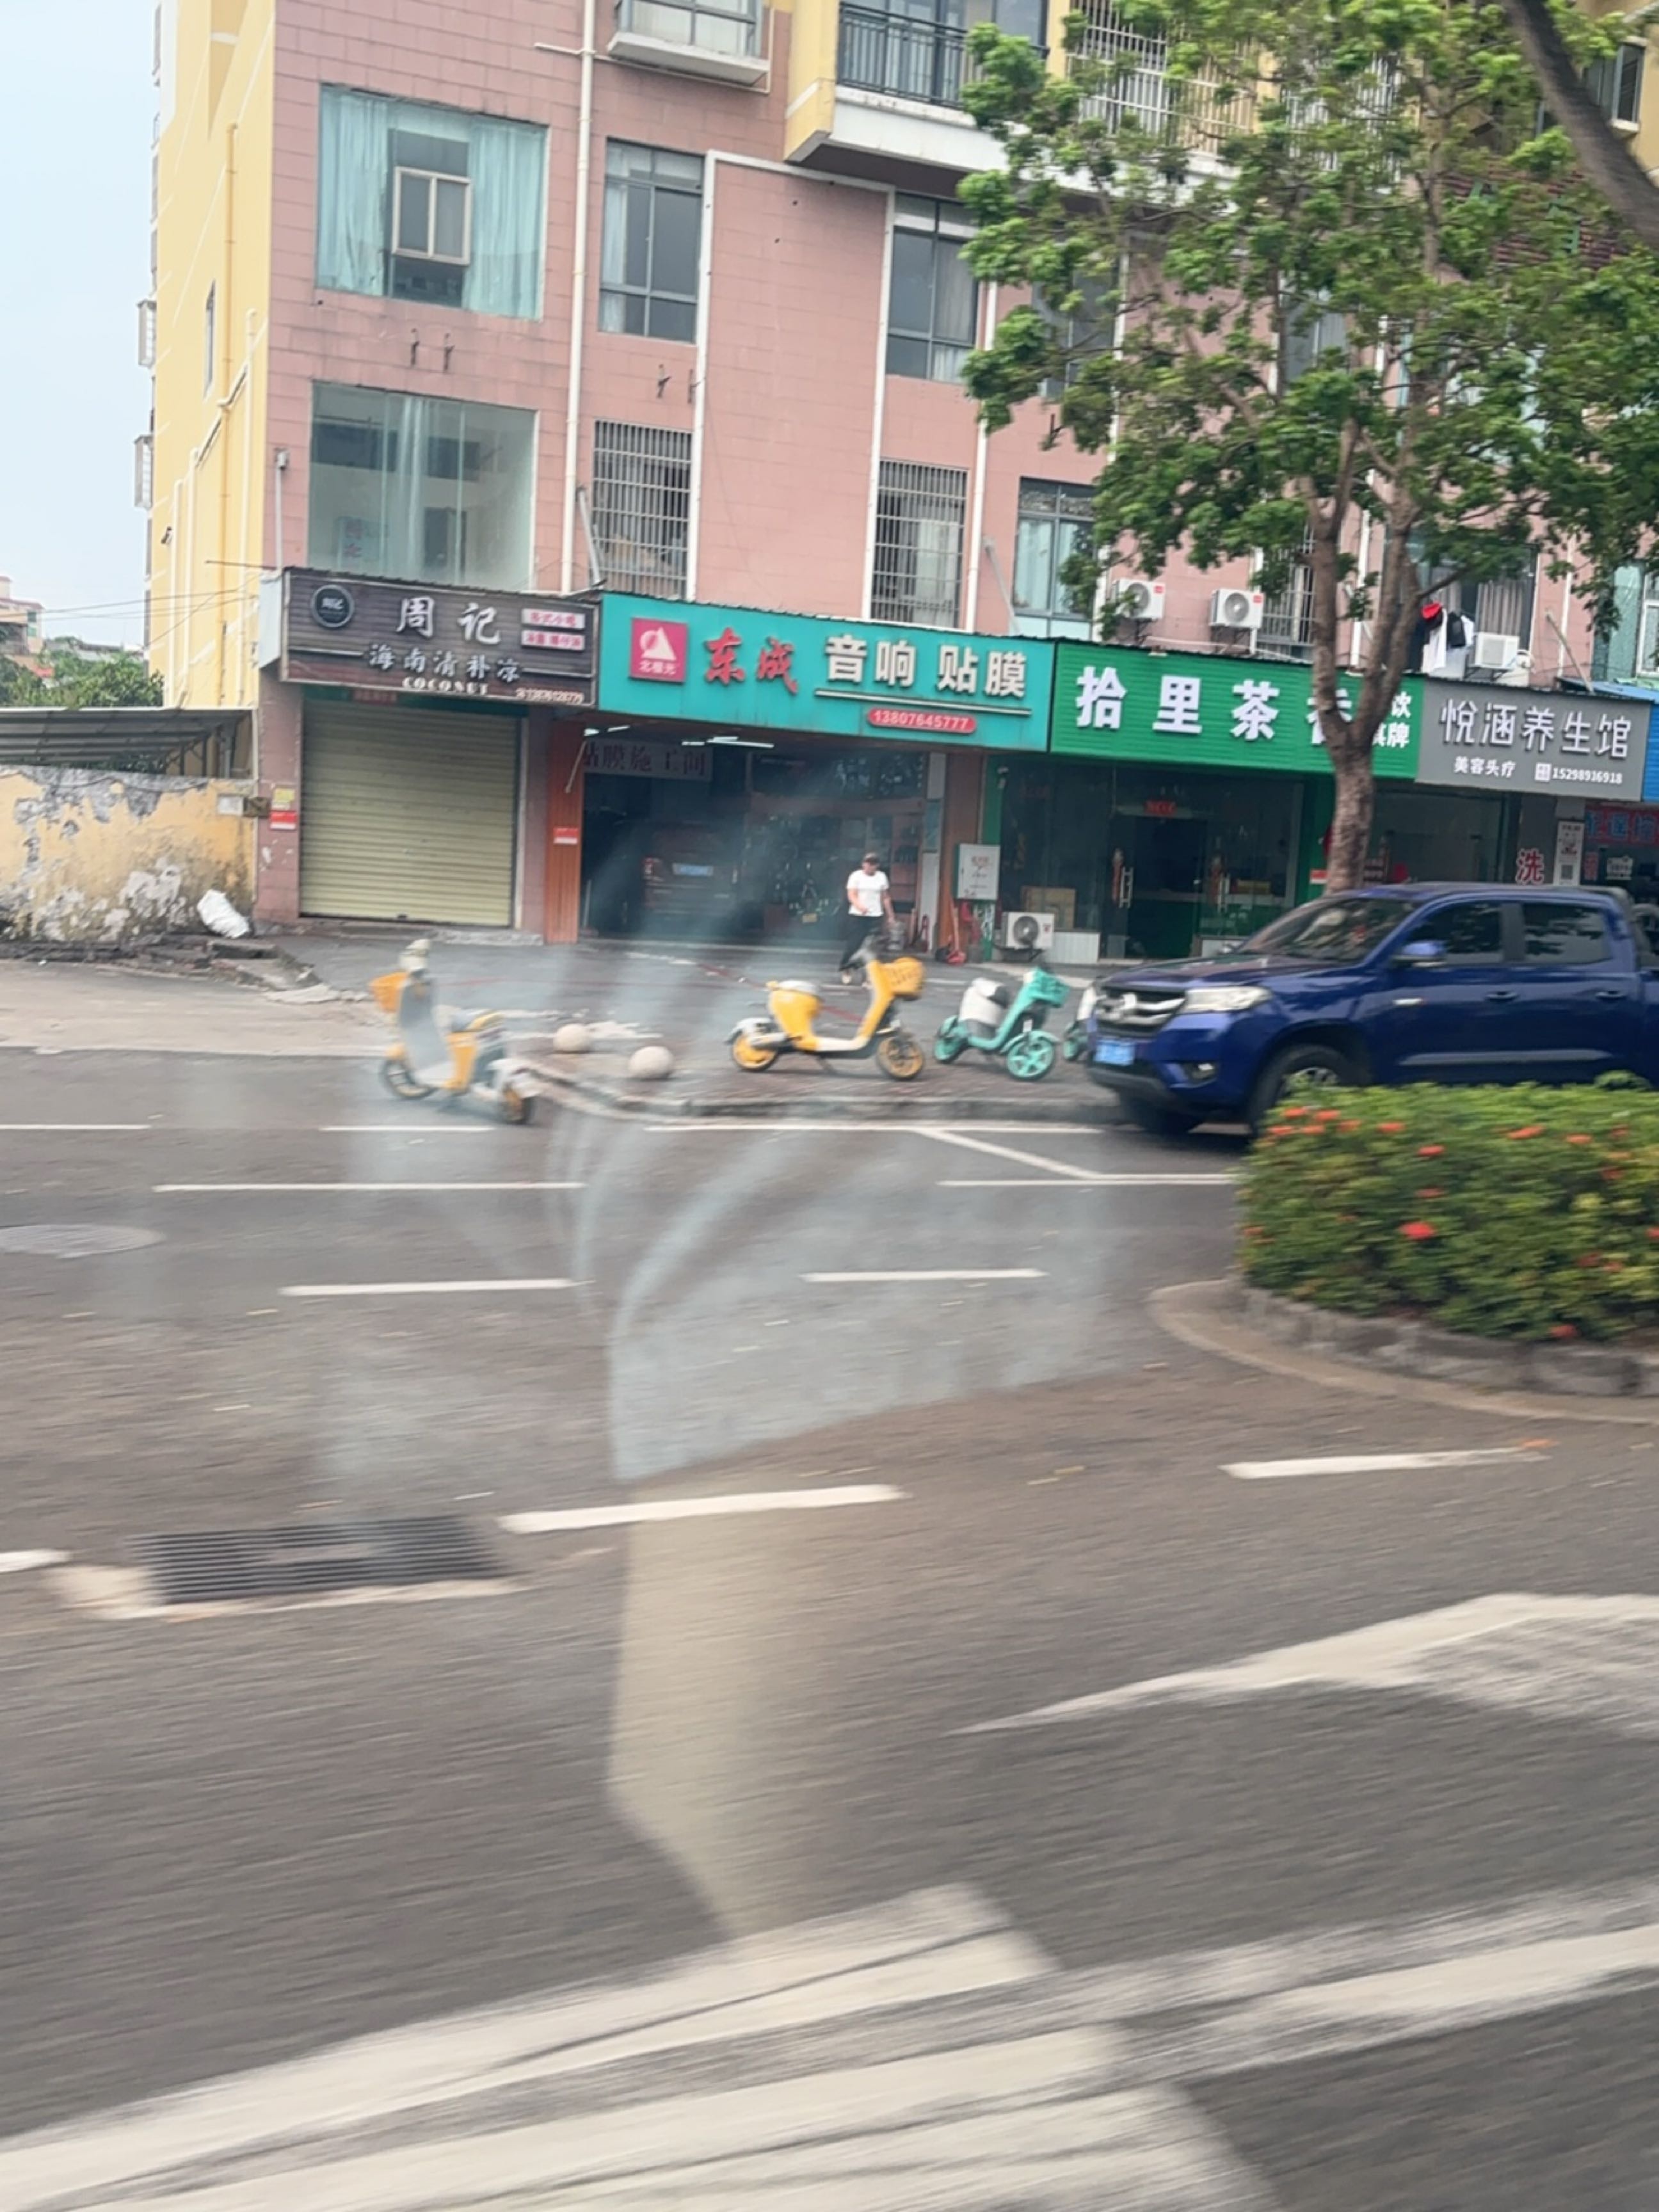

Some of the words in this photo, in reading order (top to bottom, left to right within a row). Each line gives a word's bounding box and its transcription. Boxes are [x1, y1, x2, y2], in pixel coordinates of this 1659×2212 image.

[396, 595, 501, 645] 周记
[369, 644, 520, 682] 海南清补凉
[705, 627, 798, 694] 东成
[824, 634, 917, 687] 音响
[937, 645, 1027, 698] 贴膜
[402, 677, 489, 695] COCONUT
[1439, 698, 1631, 758] 悦涵养生馆
[1454, 755, 1516, 778] 美容头疗
